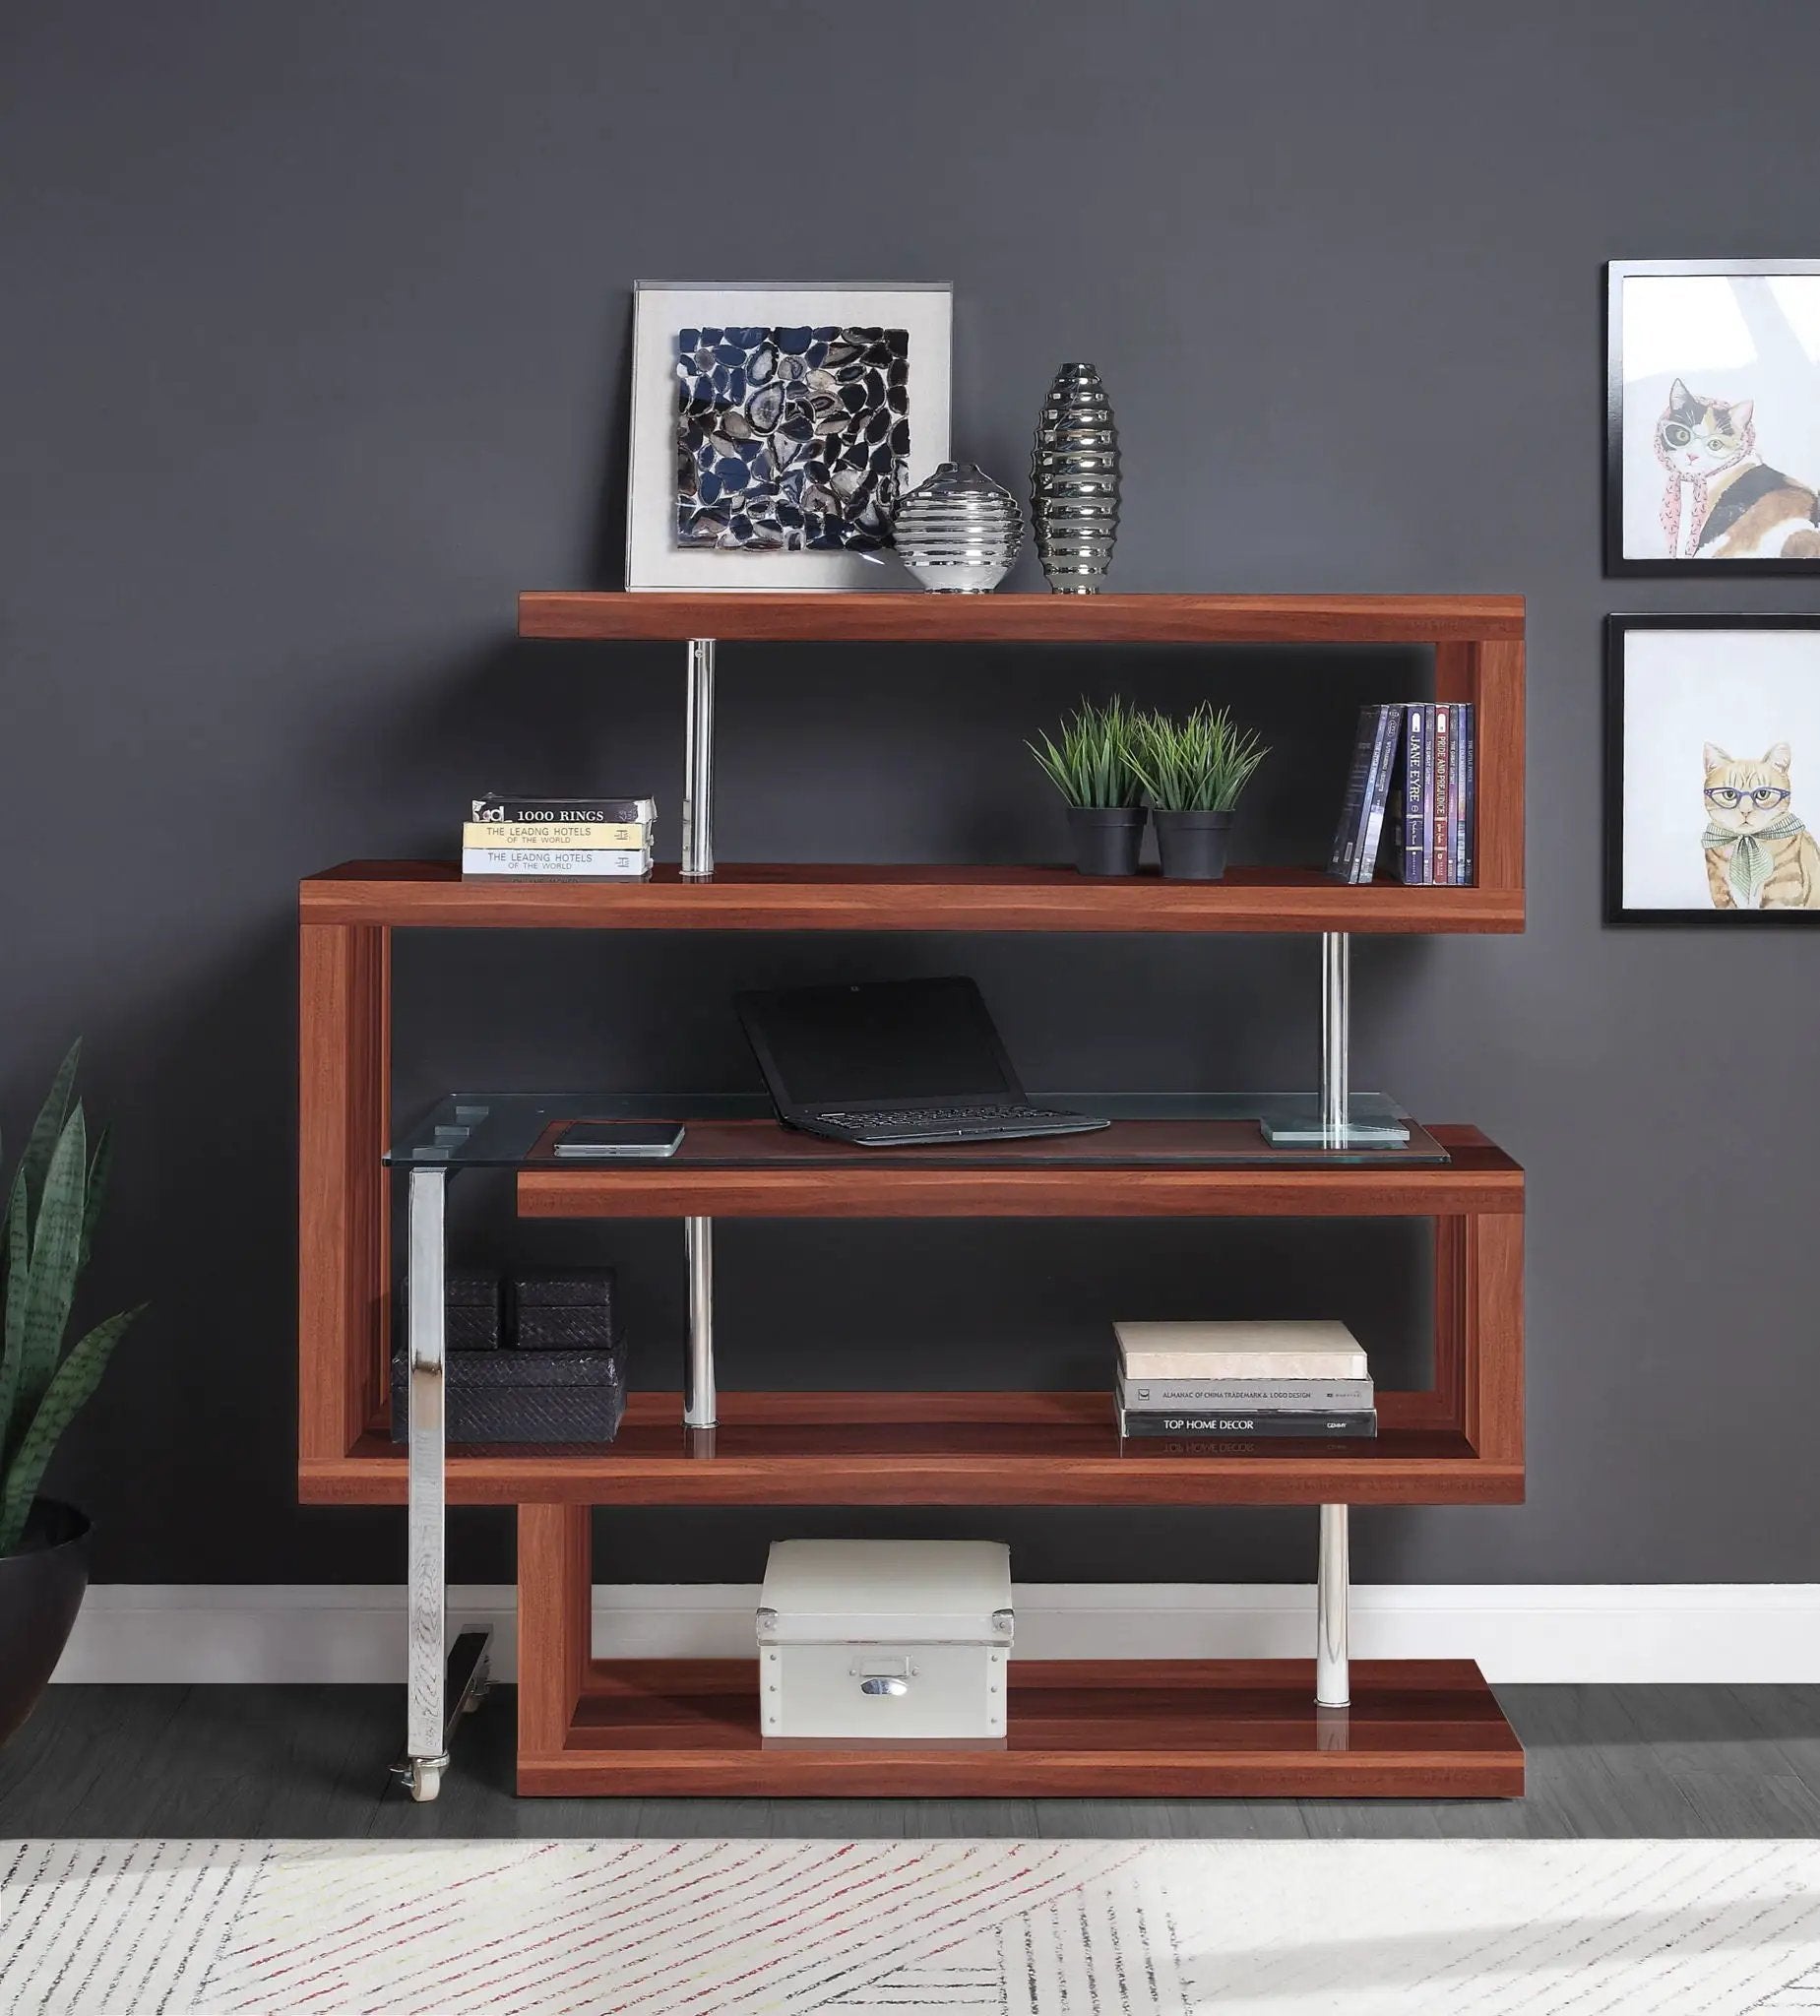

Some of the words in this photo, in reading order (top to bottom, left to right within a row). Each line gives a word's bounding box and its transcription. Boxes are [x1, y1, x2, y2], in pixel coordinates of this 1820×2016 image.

[1410, 735, 1421, 767] JANE
[1437, 736, 1446, 758] PRIDE
[1437, 758, 1446, 774] AND
[1410, 770, 1422, 802] EYRE
[1436, 775, 1446, 814] PREJUDICE
[517, 810, 554, 821] 1000
[560, 810, 603, 821] RINGS
[486, 827, 504, 836] THE
[510, 827, 549, 836] LEADNG
[554, 827, 591, 836] HOTELS
[488, 852, 506, 861] THE
[511, 852, 550, 862] LEADNG
[555, 853, 593, 862] HOTELS
[1163, 1420, 1184, 1429] TOP
[1186, 1420, 1217, 1429] HOME
[1220, 1420, 1254, 1429] DECOR
